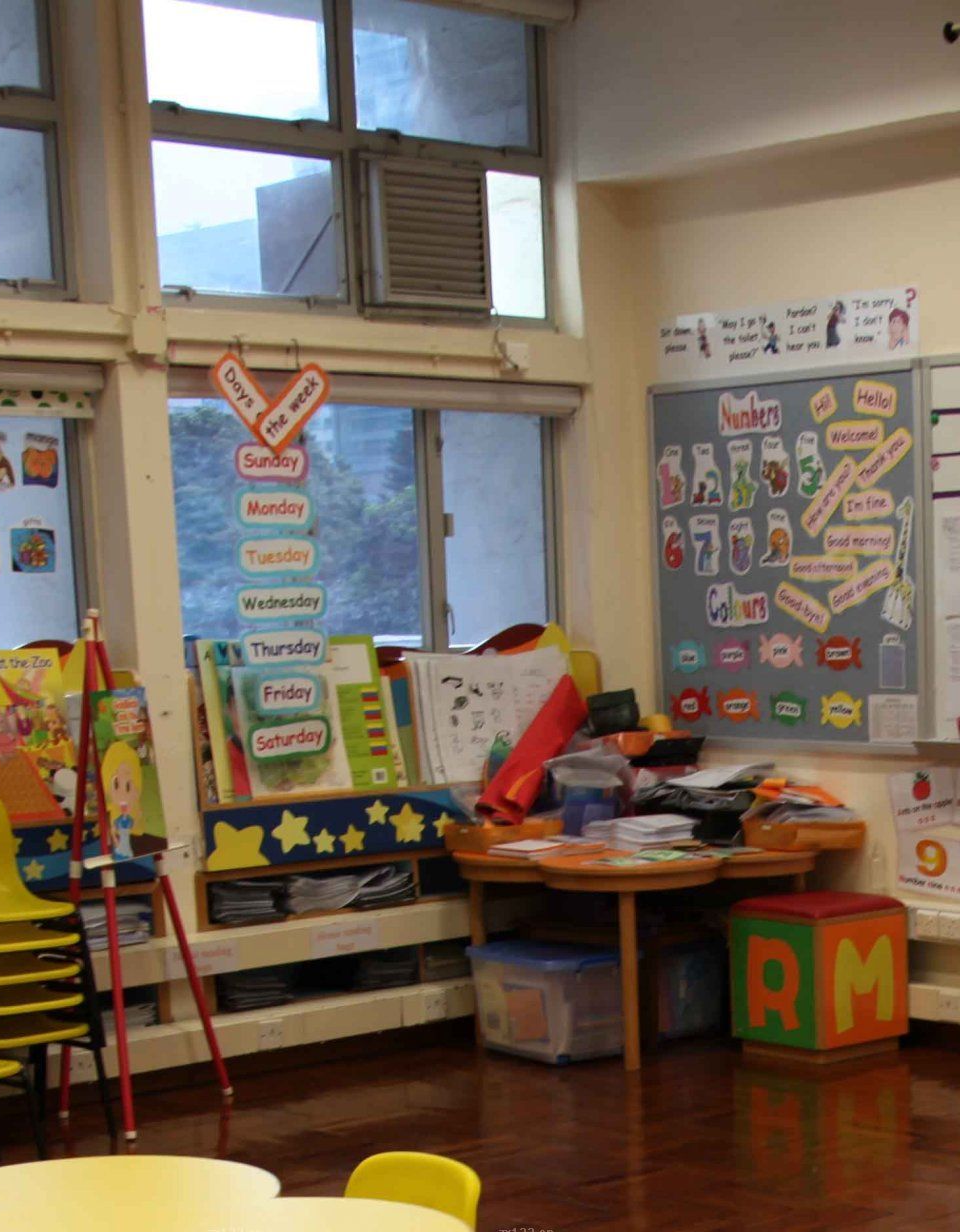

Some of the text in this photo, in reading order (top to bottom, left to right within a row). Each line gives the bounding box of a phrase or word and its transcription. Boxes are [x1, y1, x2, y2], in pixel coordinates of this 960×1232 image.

[223, 366, 255, 409] Days
[857, 387, 893, 410] Hello!
[265, 376, 319, 438] the week
[721, 394, 780, 432] Numbers
[243, 452, 299, 471] Sunday
[246, 499, 305, 517] Monday
[246, 549, 310, 565] Tuesday
[242, 594, 320, 610] Wednesday
[708, 585, 768, 622] Colours
[250, 638, 320, 657] Thursday
[10, 656, 29, 669] the
[31, 655, 53, 669] Zoo
[263, 683, 313, 703] Friday
[256, 728, 323, 751] Saturday
[915, 839, 947, 877] 9
[746, 934, 801, 1031] R
[834, 934, 894, 1034] M
